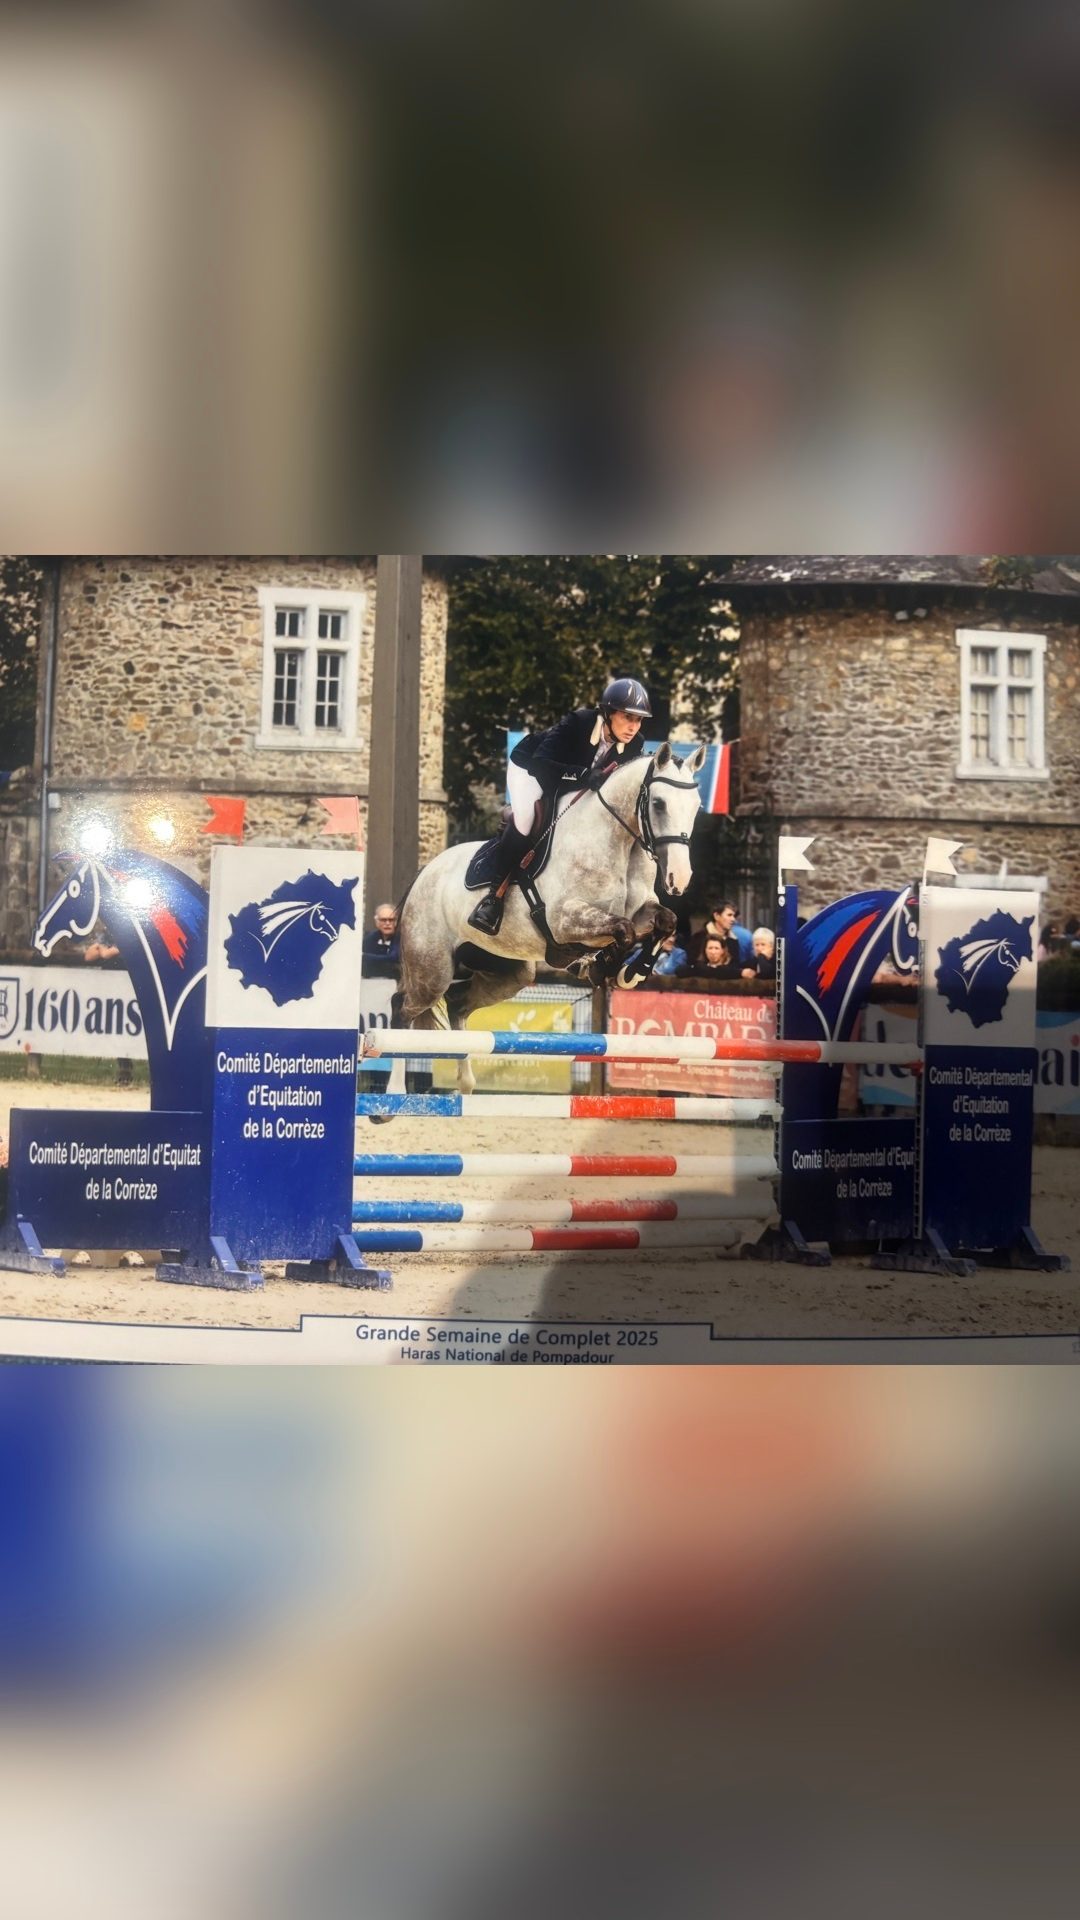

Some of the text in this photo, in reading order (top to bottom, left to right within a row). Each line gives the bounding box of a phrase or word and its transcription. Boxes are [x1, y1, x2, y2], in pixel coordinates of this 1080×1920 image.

[24, 988, 80, 1033] 160
[85, 997, 142, 1036] ans
[694, 999, 773, 1023] Château de
[216, 1051, 355, 1078] Comité Départemental
[928, 1066, 1033, 1089] Comité Départemental
[247, 1085, 322, 1111] d'Equitation
[952, 1095, 1009, 1117] d'Equitation
[243, 1118, 325, 1139] de la Corrèze
[948, 1123, 1012, 1142] de la Corrèze
[28, 1141, 201, 1170] Comité Départemental d'Equitat
[791, 1149, 823, 1170] Comité
[824, 1147, 886, 1173] Départemental
[85, 1178, 158, 1200] de la Corrèze
[836, 1177, 893, 1198] de la Corrèze
[355, 1324, 659, 1349] Grande Semaine de Complet 2025
[400, 1346, 615, 1365] Haras National de Pompadour
